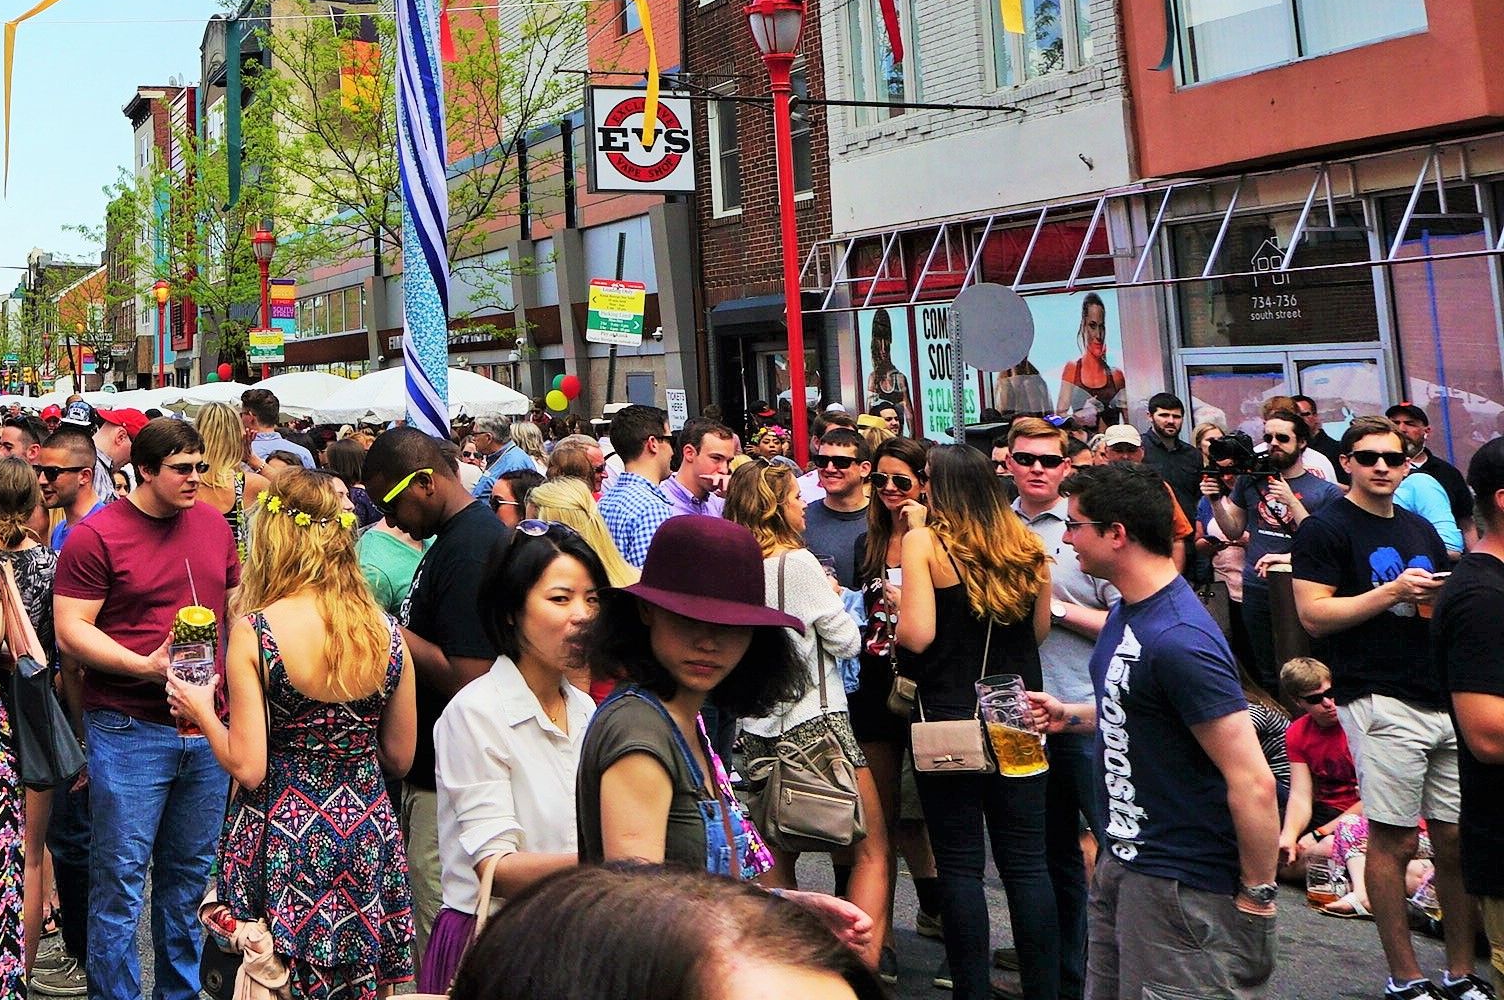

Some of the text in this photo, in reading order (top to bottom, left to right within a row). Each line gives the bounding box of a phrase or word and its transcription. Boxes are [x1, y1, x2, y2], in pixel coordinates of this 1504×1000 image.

[598, 127, 691, 153] EVS
[616, 157, 673, 178] VAPE SHOP
[1251, 294, 1298, 309] 734-736
[1250, 309, 1302, 321] south street
[928, 388, 975, 414] 3 CLAES
[929, 416, 935, 432] &
